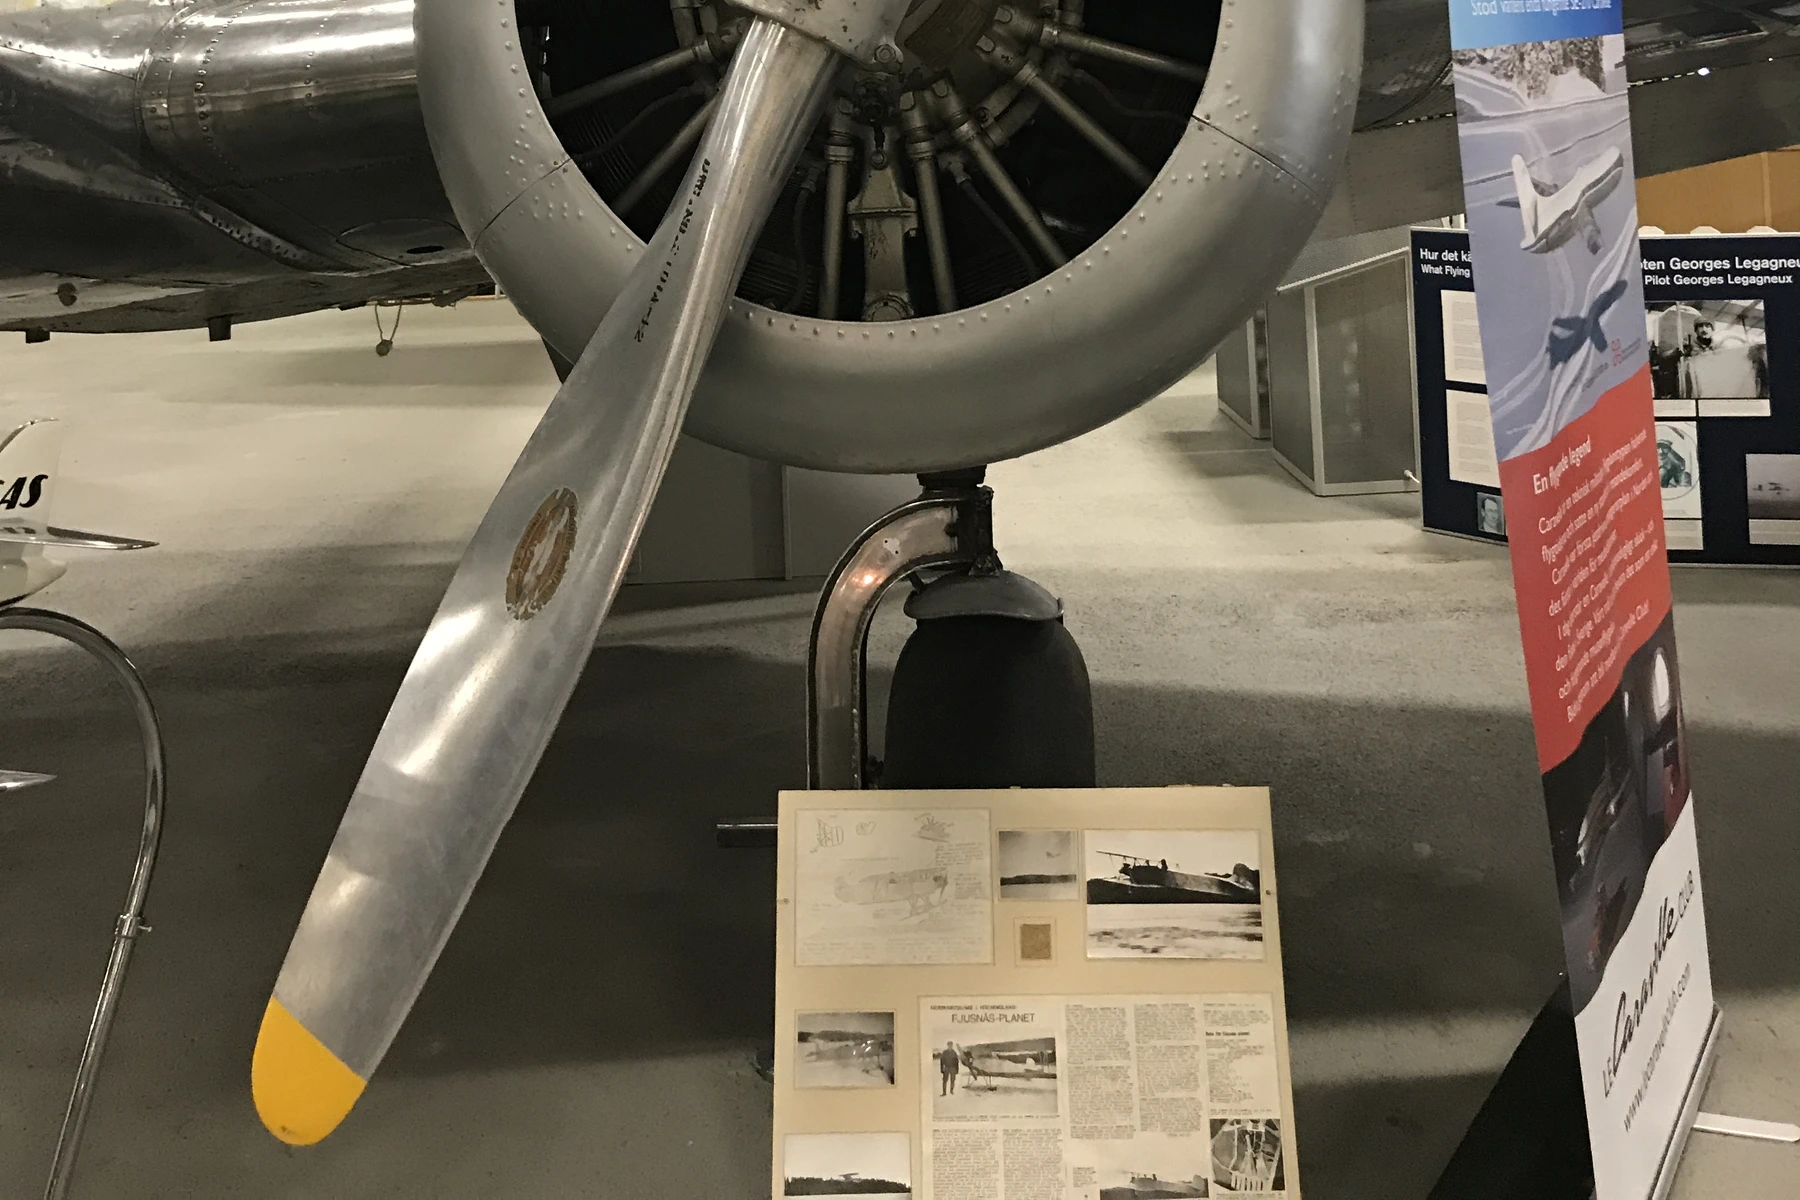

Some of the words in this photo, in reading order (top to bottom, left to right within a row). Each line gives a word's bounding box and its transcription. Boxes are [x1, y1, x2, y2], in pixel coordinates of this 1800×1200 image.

[1420, 247, 1439, 260] Hur
[1441, 250, 1459, 261] det
[1421, 263, 1443, 274] What
[1445, 266, 1470, 278] Flying
[1669, 257, 1731, 272] Georges
[1645, 275, 1670, 285] Pilot
[1673, 275, 1724, 286] Georges
[1728, 274, 1793, 286] Legagneux
[1533, 473, 1548, 495] En
[1568, 434, 1591, 467] legend
[0, 474, 49, 510] AS
